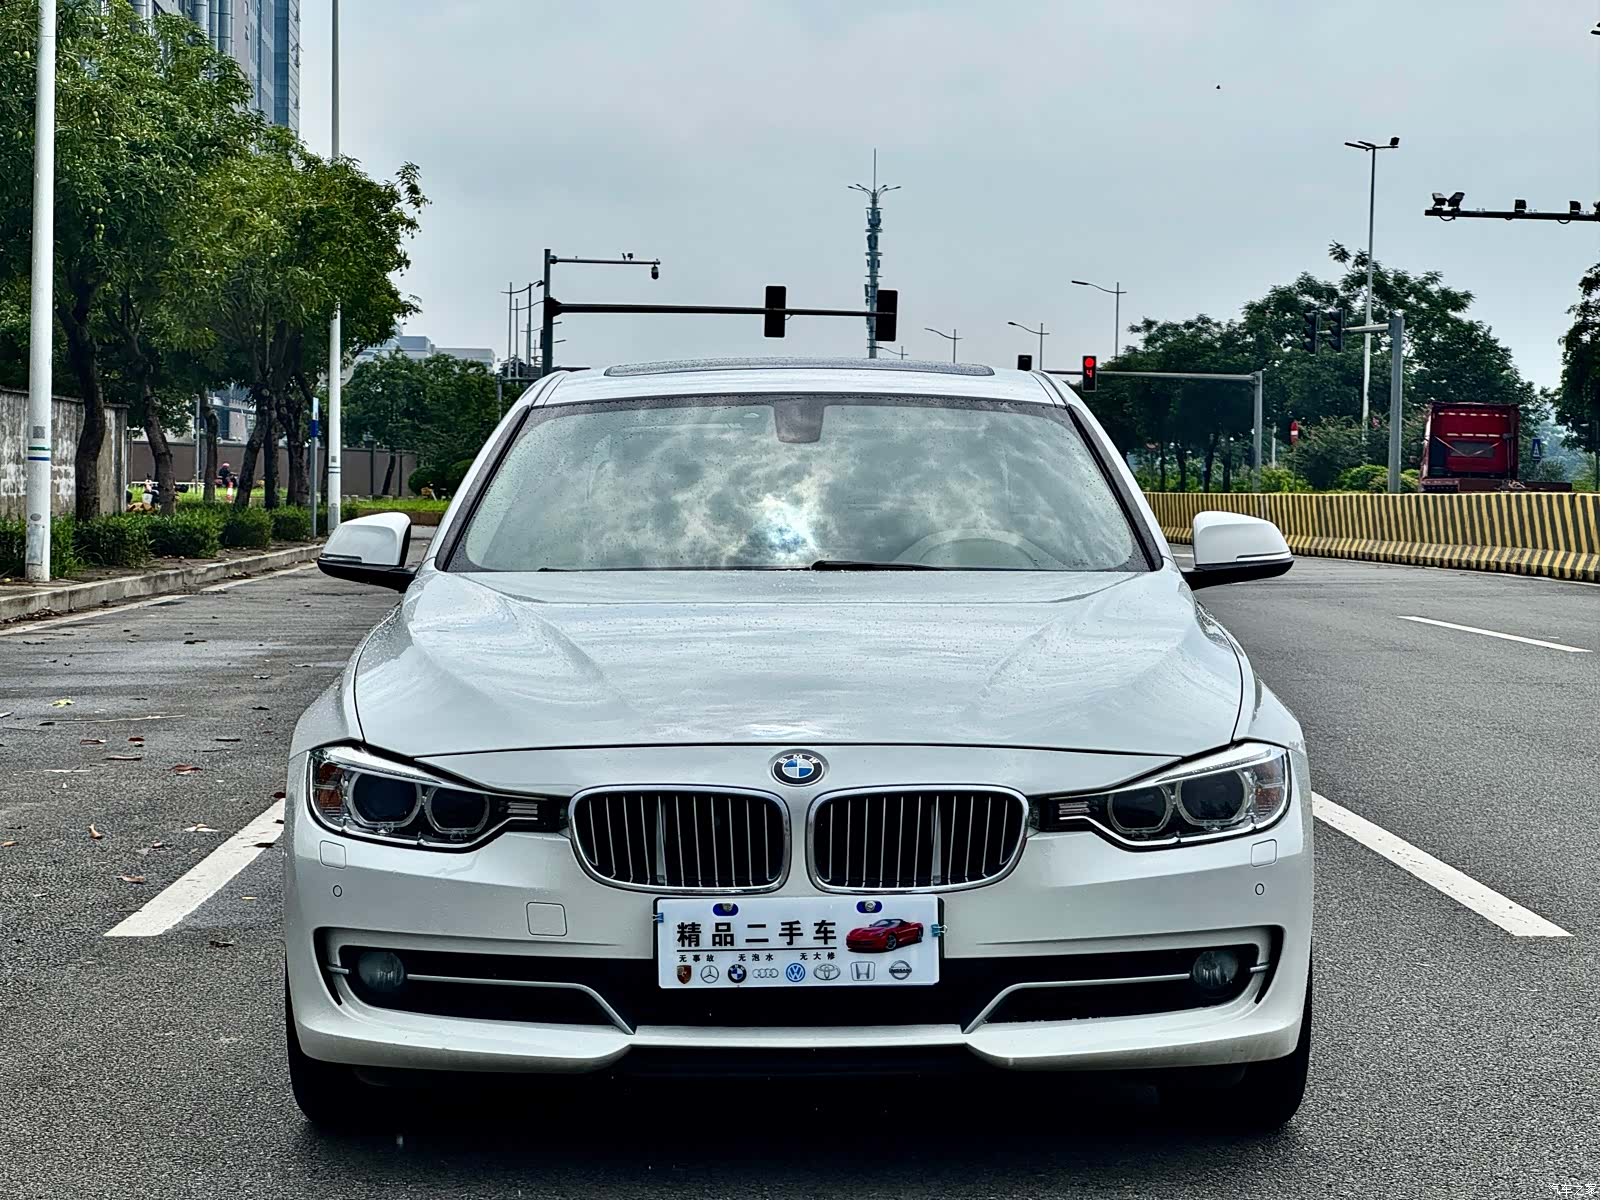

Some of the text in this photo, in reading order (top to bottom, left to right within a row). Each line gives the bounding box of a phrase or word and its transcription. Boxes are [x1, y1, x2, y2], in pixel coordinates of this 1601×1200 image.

[1086, 369, 1093, 378] 4
[676, 919, 837, 947] 精品二手车
[678, 952, 836, 963] 无事故 无泡水 无大修
